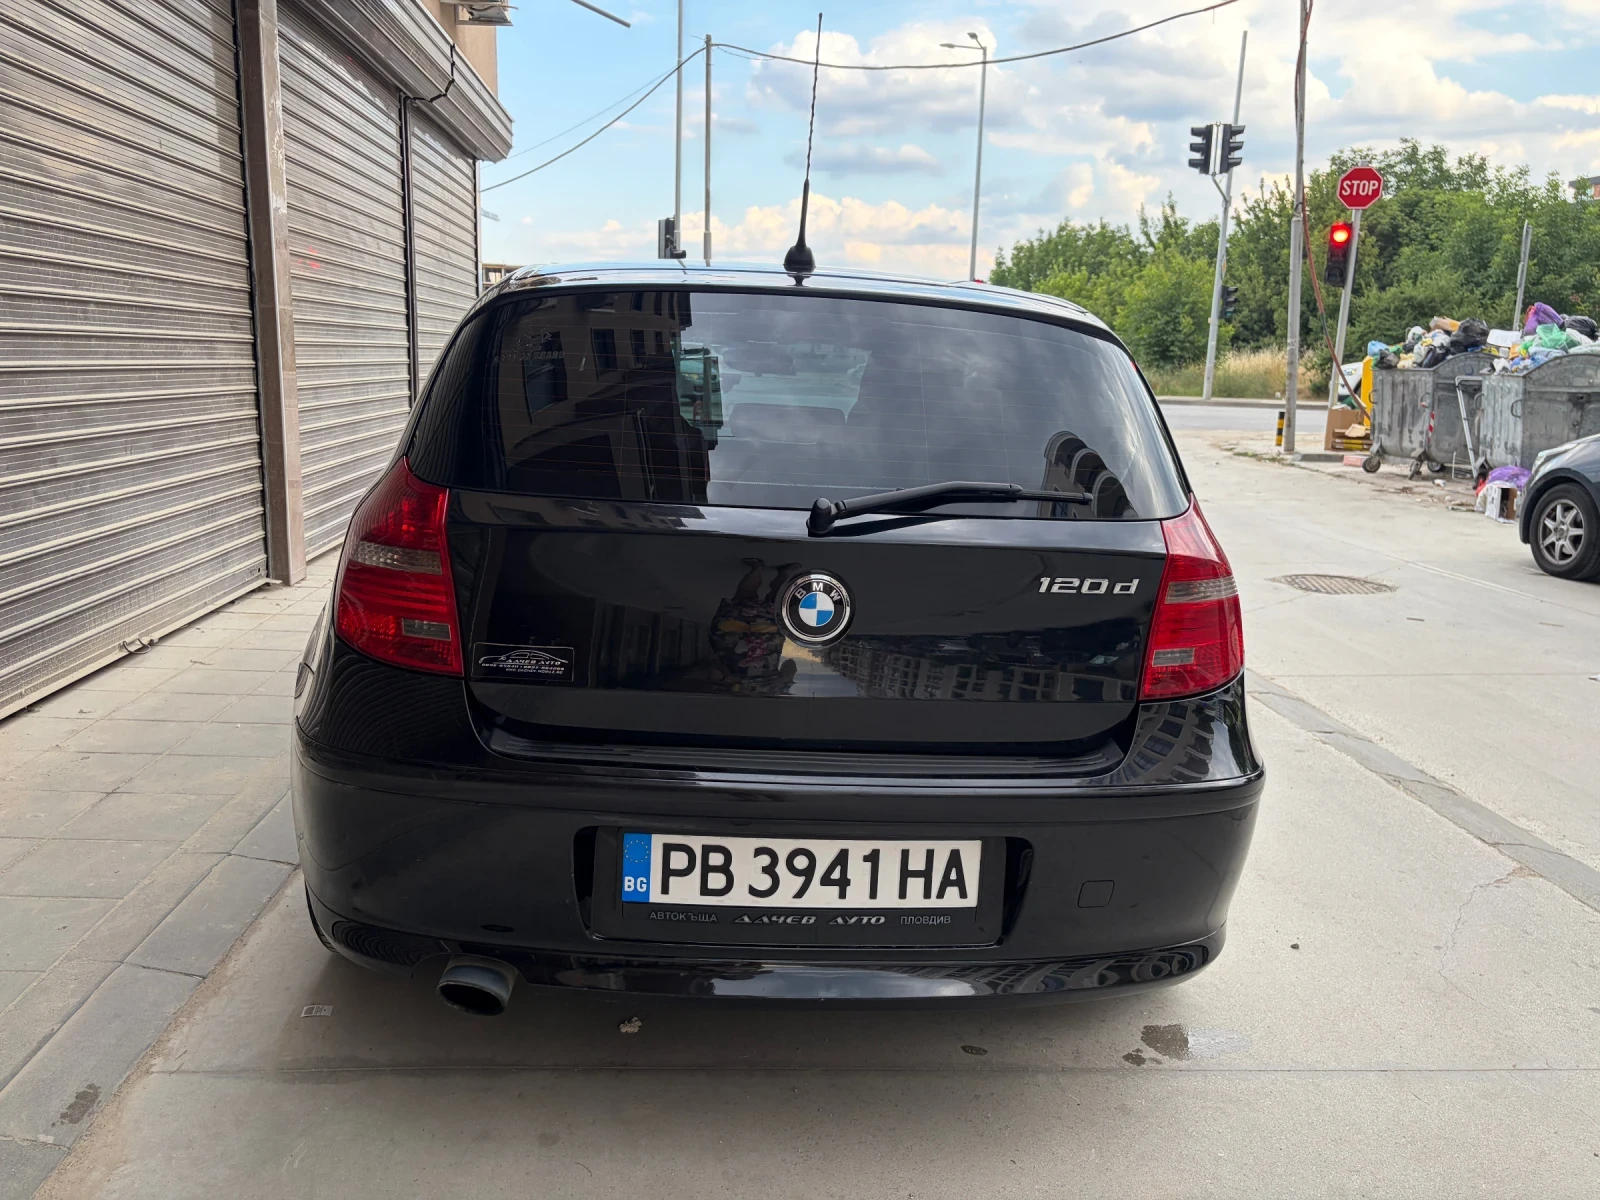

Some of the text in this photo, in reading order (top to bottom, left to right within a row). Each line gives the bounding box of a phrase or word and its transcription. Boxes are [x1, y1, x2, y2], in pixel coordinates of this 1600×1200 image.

[1341, 180, 1379, 196] STOP
[794, 582, 842, 602] BMW
[1038, 577, 1140, 595] 120d
[660, 842, 968, 900] PB 3941 HA
[624, 876, 648, 893] BG
[900, 915, 952, 926] ПЛОВДИВ
